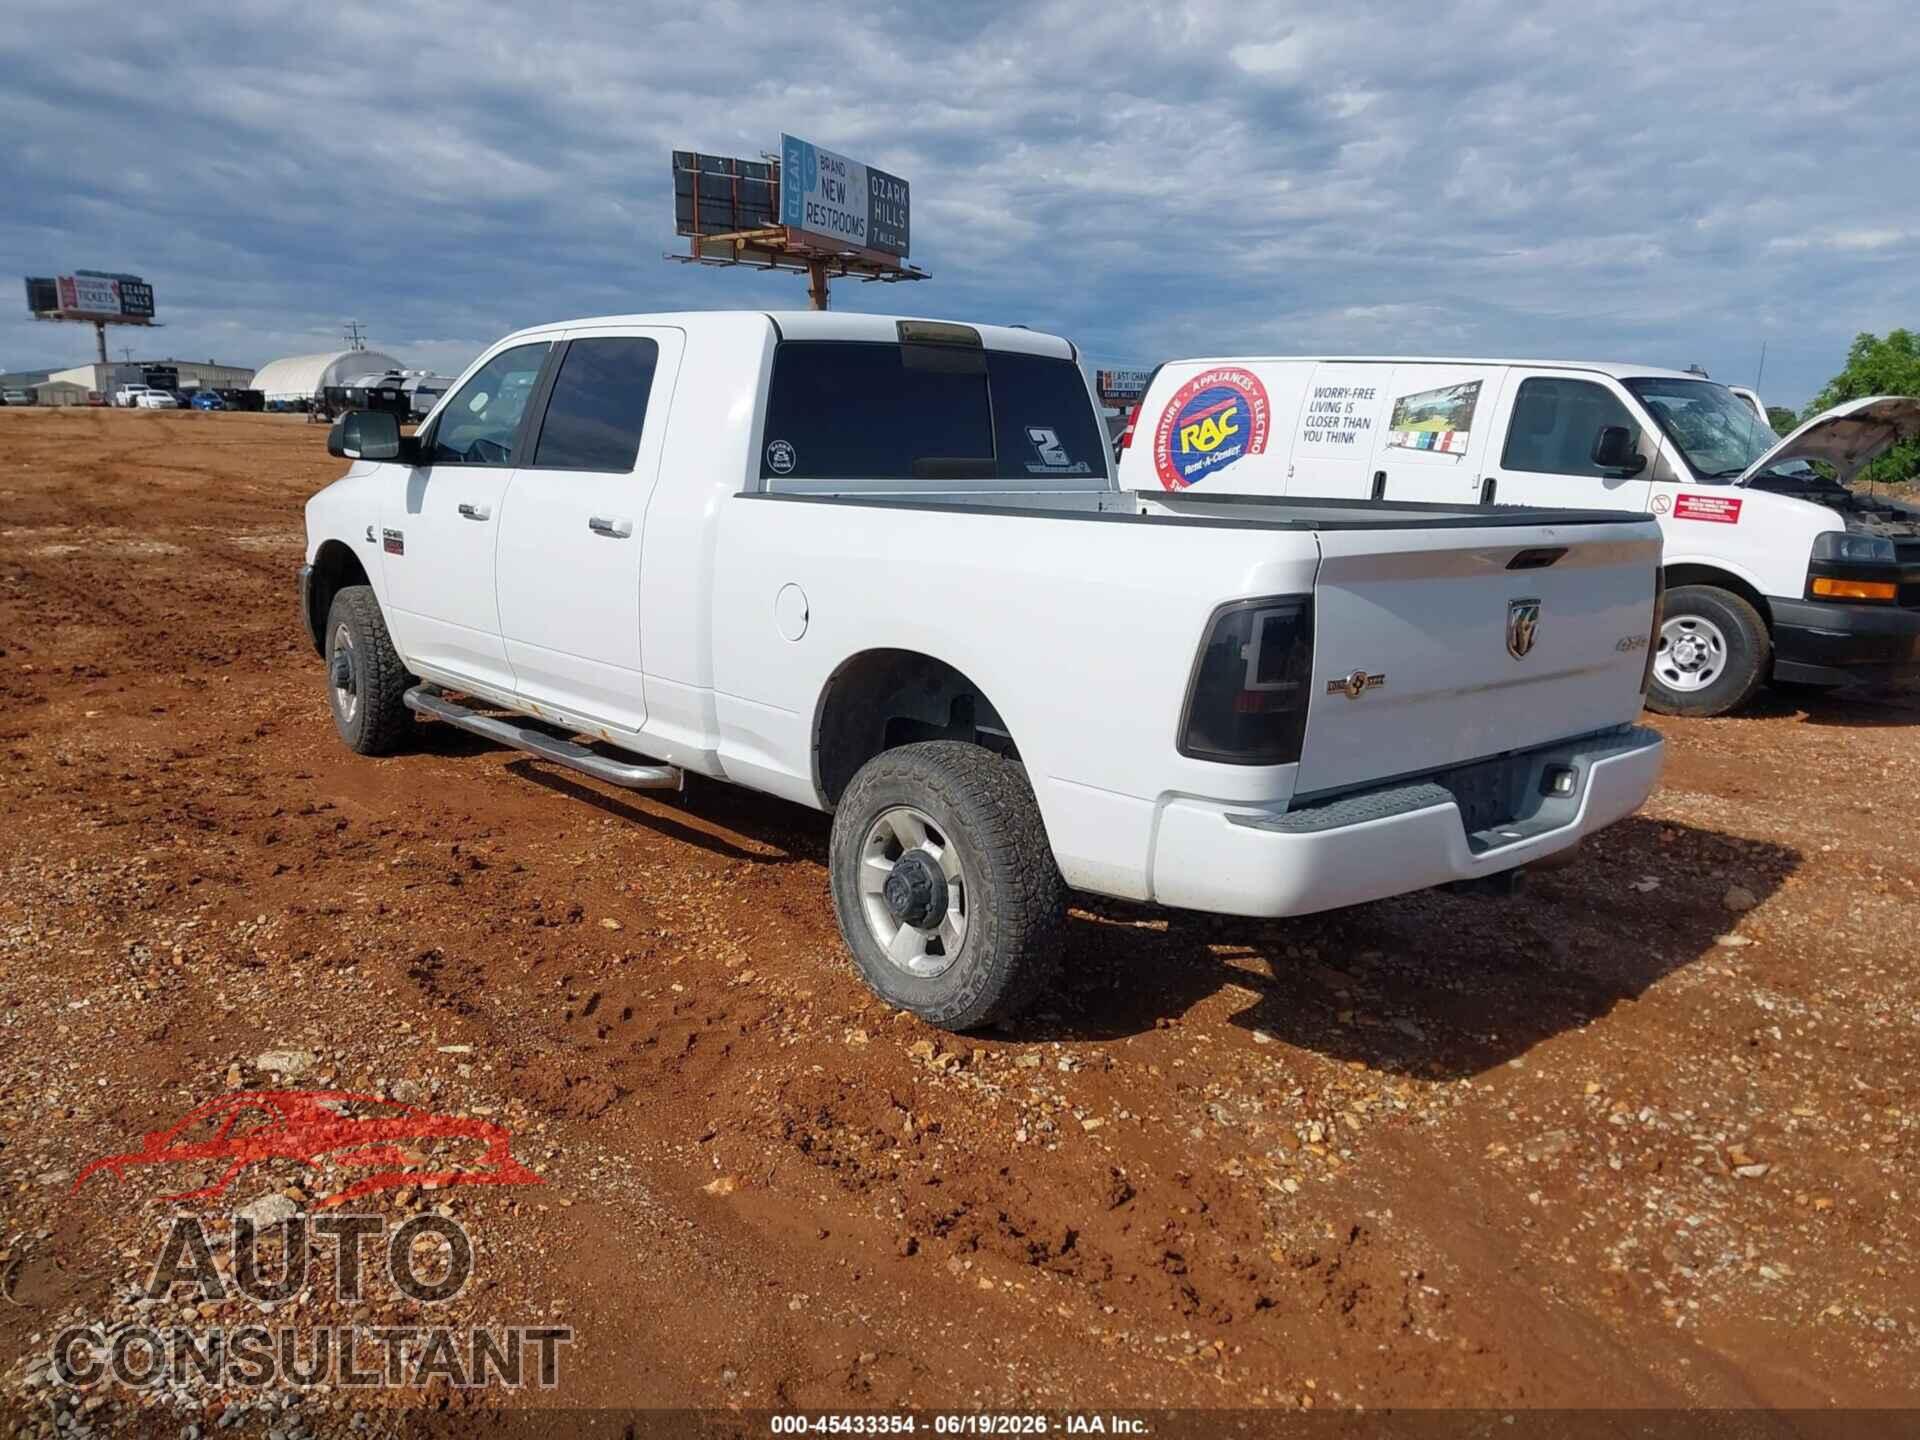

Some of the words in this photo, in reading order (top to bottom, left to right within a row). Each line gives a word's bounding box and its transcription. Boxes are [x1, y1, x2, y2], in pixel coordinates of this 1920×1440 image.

[820, 154, 846, 177] BRAND
[788, 149, 800, 218] CLEAN
[821, 176, 847, 204] NEW
[871, 175, 907, 206] OZARK
[806, 201, 865, 238] RESTROOMS
[874, 199, 905, 229] HILLS
[1308, 401, 1342, 414] LIVING
[1344, 402, 1355, 414] IS
[1313, 386, 1377, 401] WORRY-FREE
[1157, 397, 1182, 470] FURNITURE
[1192, 371, 1254, 392] APPLIANCES
[1180, 406, 1239, 455] RAC
[1305, 415, 1341, 429] CLOSER
[1343, 416, 1372, 430] THAN
[1028, 428, 1070, 467] 2
[1302, 430, 1323, 443] YOU
[1325, 431, 1358, 444] THINK
